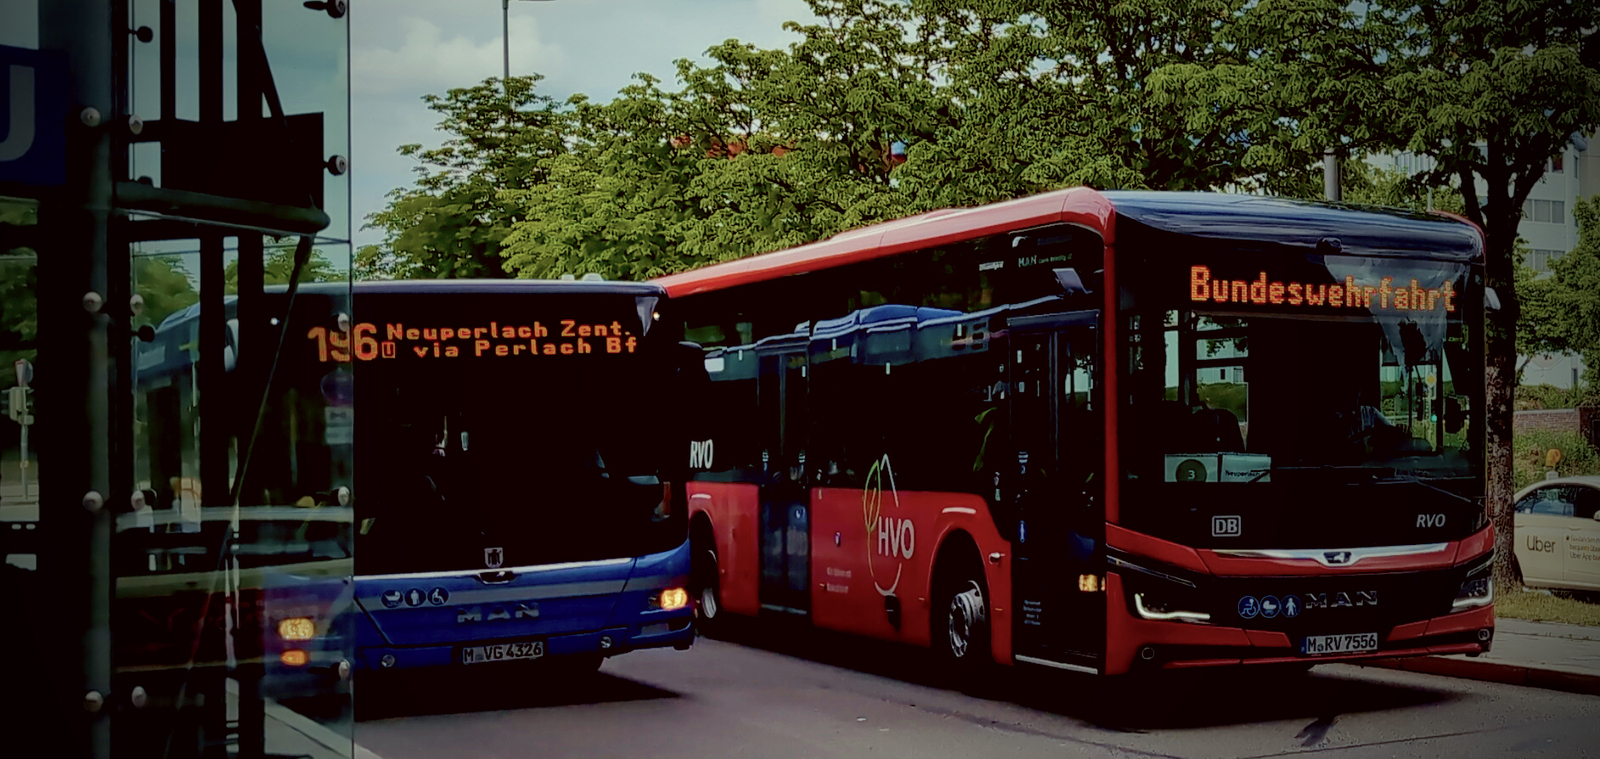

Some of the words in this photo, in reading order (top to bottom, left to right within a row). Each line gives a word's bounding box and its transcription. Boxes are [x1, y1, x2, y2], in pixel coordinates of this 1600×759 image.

[1190, 265, 1456, 312] Bundeswehrfahrt
[387, 321, 548, 341] Neuperlach
[560, 319, 631, 337] Zent.
[308, 323, 377, 362] 196
[414, 343, 459, 358] via
[475, 338, 591, 357] Perlach
[606, 336, 637, 354] Bf
[689, 438, 714, 469] RVO
[1187, 469, 1196, 480] 3
[1215, 518, 1238, 534] DB
[1416, 513, 1446, 528] RVO
[878, 515, 915, 560] HVO
[1526, 534, 1556, 553] Uber
[1305, 590, 1378, 609] MAN
[457, 602, 540, 623] MAN
[506, 643, 542, 658] 4326
[1345, 634, 1376, 650] 7556
